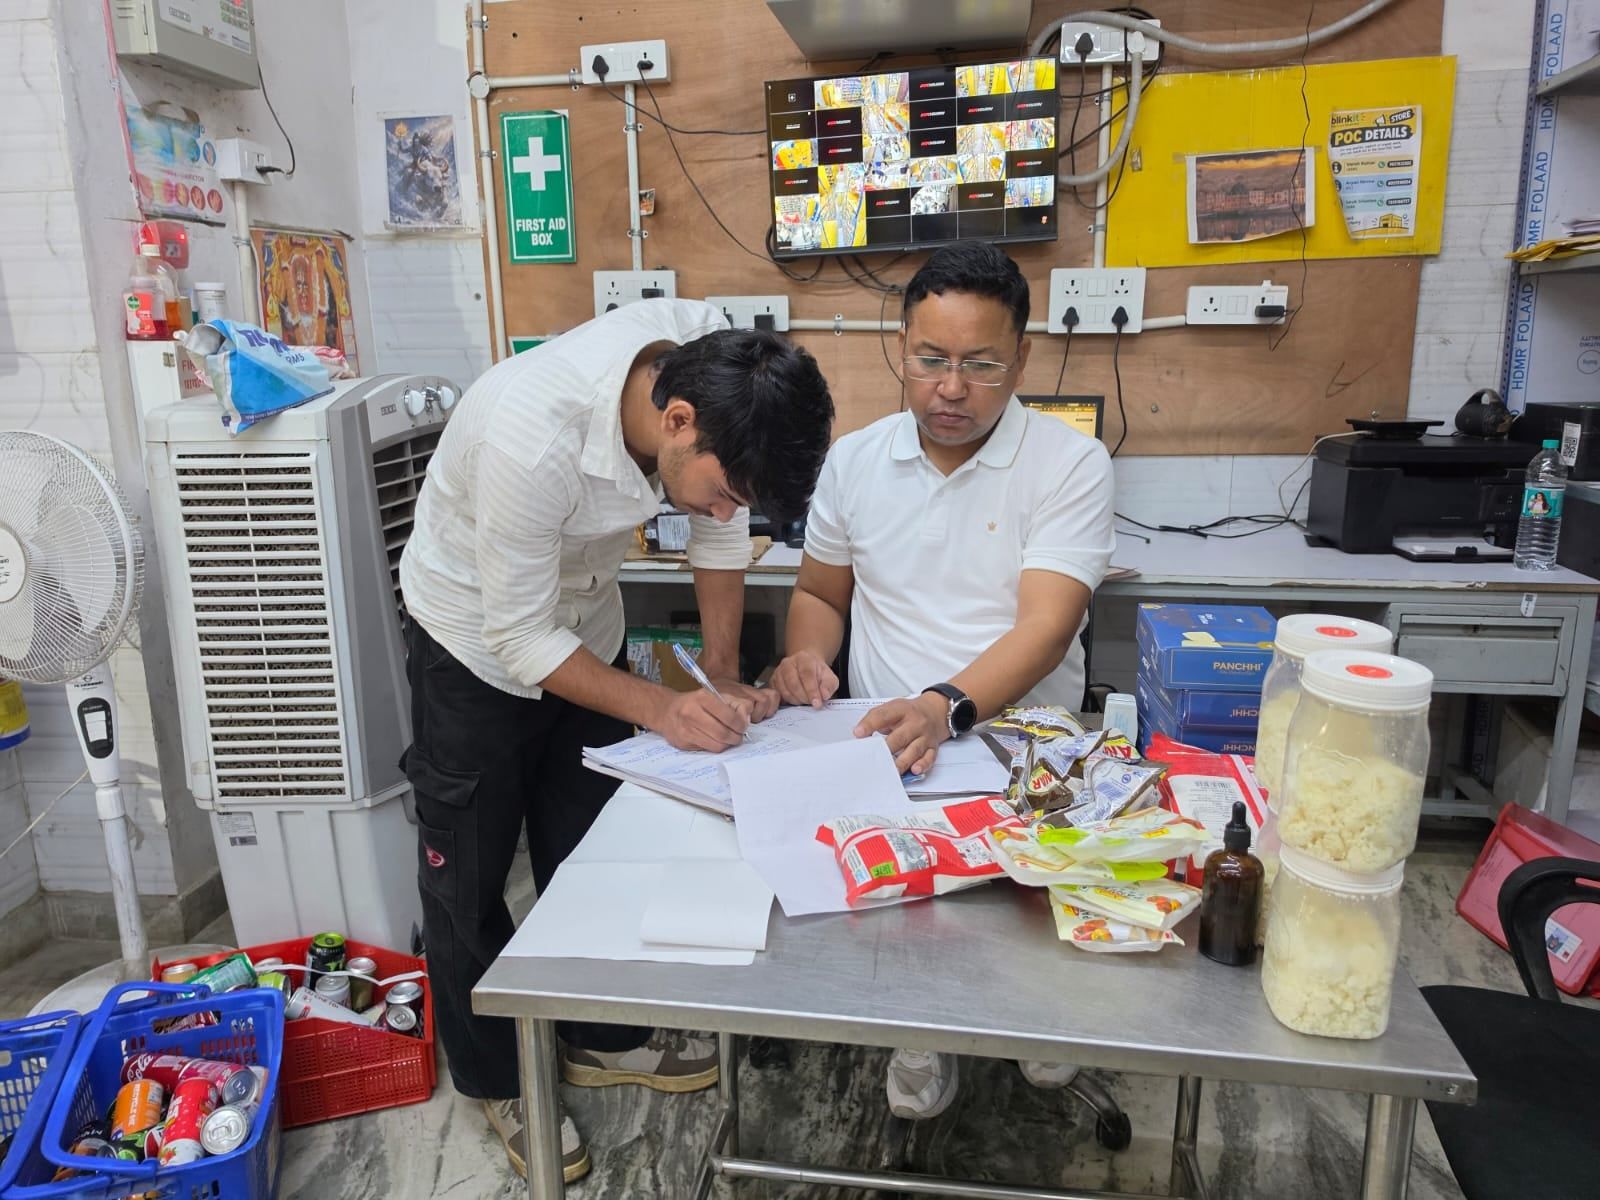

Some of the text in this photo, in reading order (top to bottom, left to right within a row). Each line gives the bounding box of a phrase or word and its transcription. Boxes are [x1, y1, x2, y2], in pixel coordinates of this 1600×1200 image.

[1540, 13, 1563, 129] HDM FOLAAD
[1331, 113, 1360, 125] blinkit
[1391, 110, 1412, 123] STORE
[1334, 126, 1408, 146] POC DETAILS
[1530, 151, 1548, 213] FOLAAD
[516, 217, 566, 232] FIRST AID
[531, 233, 553, 246] BOX
[1512, 282, 1534, 390] HDMR FOLAAD
[1213, 661, 1262, 671] PANCHHI
